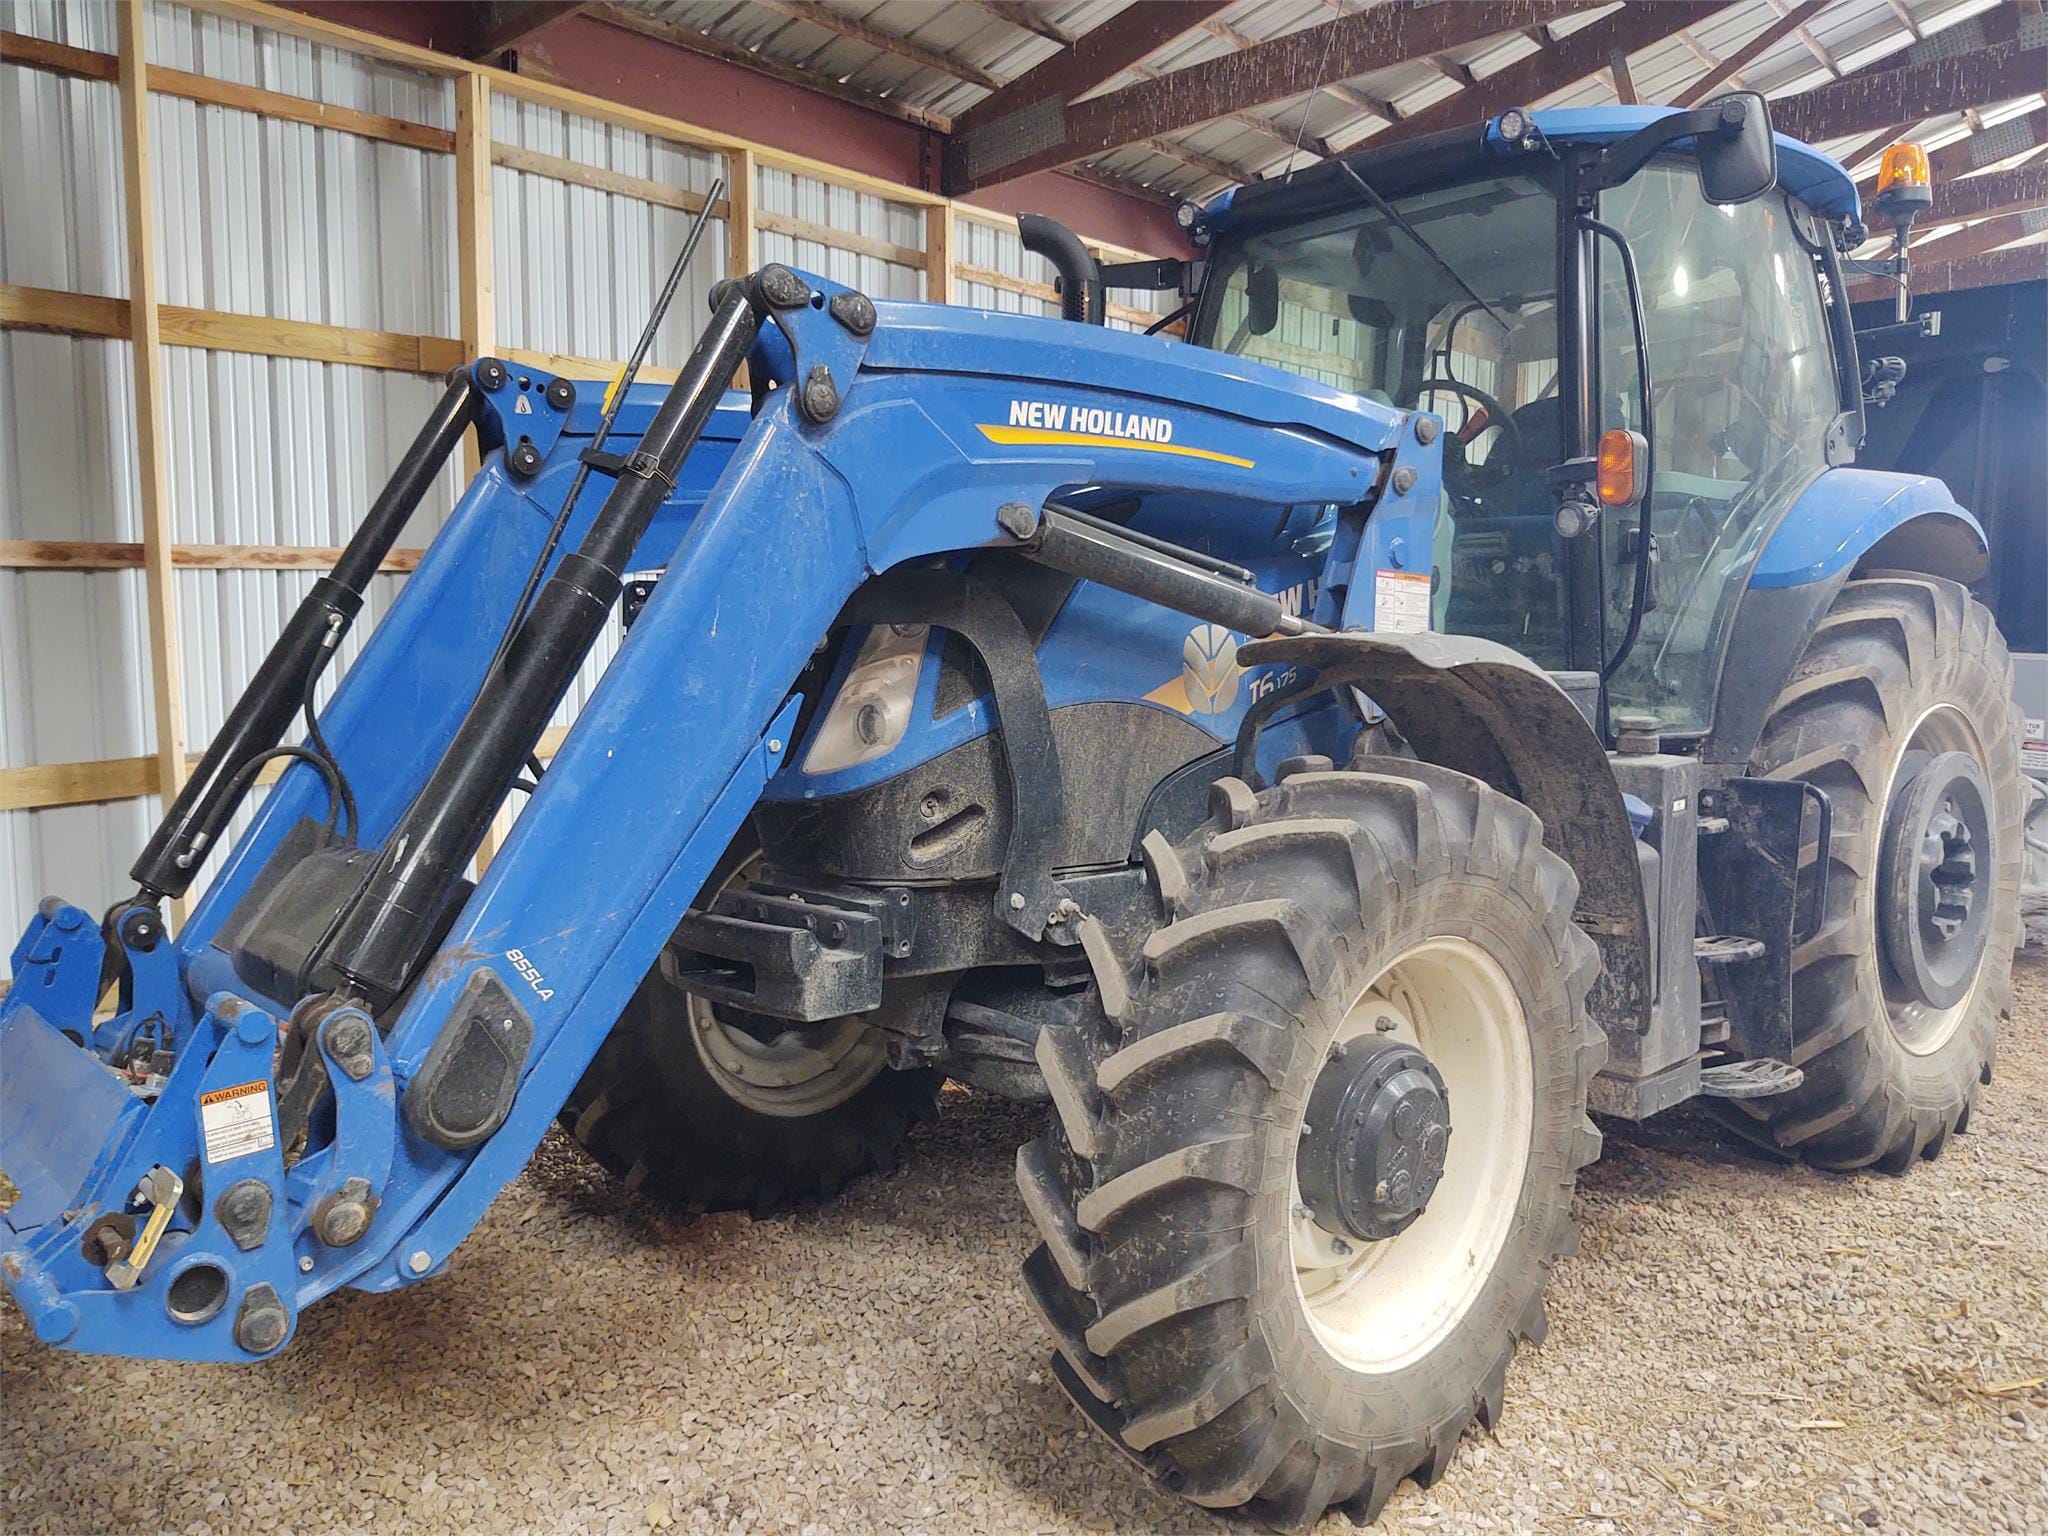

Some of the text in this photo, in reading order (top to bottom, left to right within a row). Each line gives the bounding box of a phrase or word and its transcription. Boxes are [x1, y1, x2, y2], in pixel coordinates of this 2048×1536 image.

[1009, 400, 1172, 443] NEW HOLLAND
[506, 948, 554, 1001] 855LA
[214, 1082, 266, 1102] WARNING
